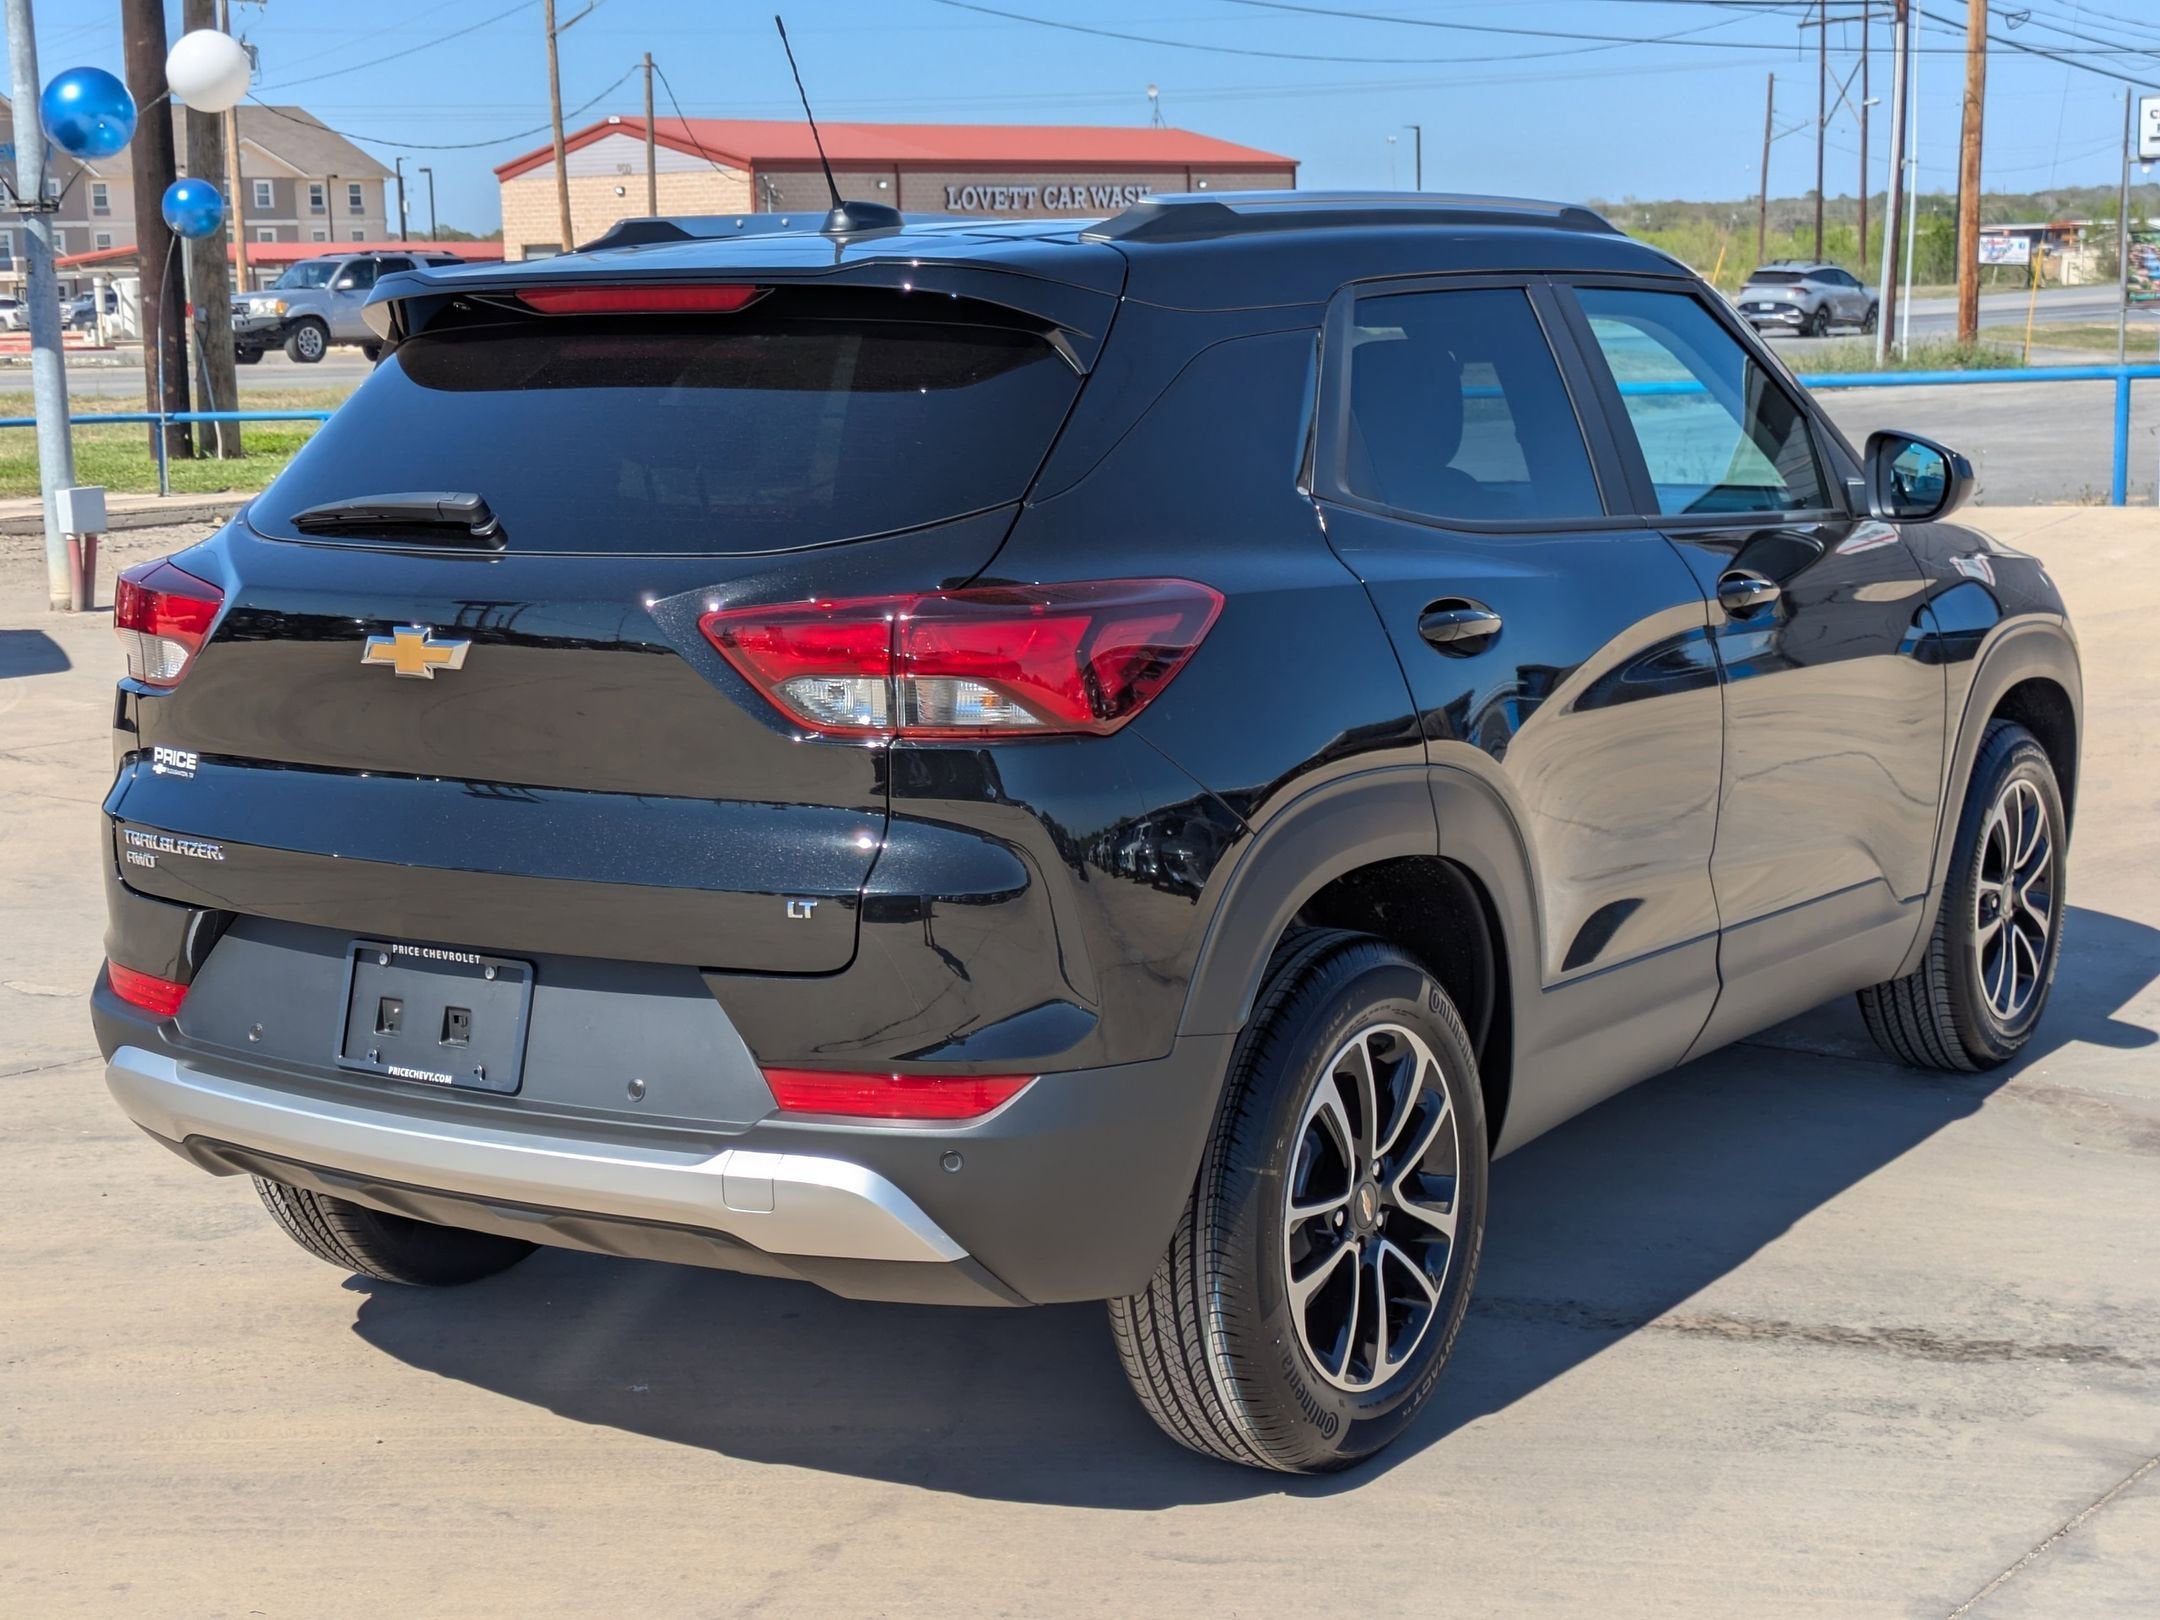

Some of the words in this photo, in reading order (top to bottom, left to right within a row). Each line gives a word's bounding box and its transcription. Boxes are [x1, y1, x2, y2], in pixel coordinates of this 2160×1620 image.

[945, 186, 1038, 209] LOVETT
[1043, 186, 1087, 209] CAR
[154, 746, 197, 770] PRICE
[123, 829, 221, 861] TRAILBLAZER
[126, 850, 155, 868] AWD
[787, 901, 818, 919] LT
[392, 944, 420, 957] PRICE
[422, 948, 481, 965] CHEVROLET
[388, 1065, 453, 1084] PRICECHEVY.COM
